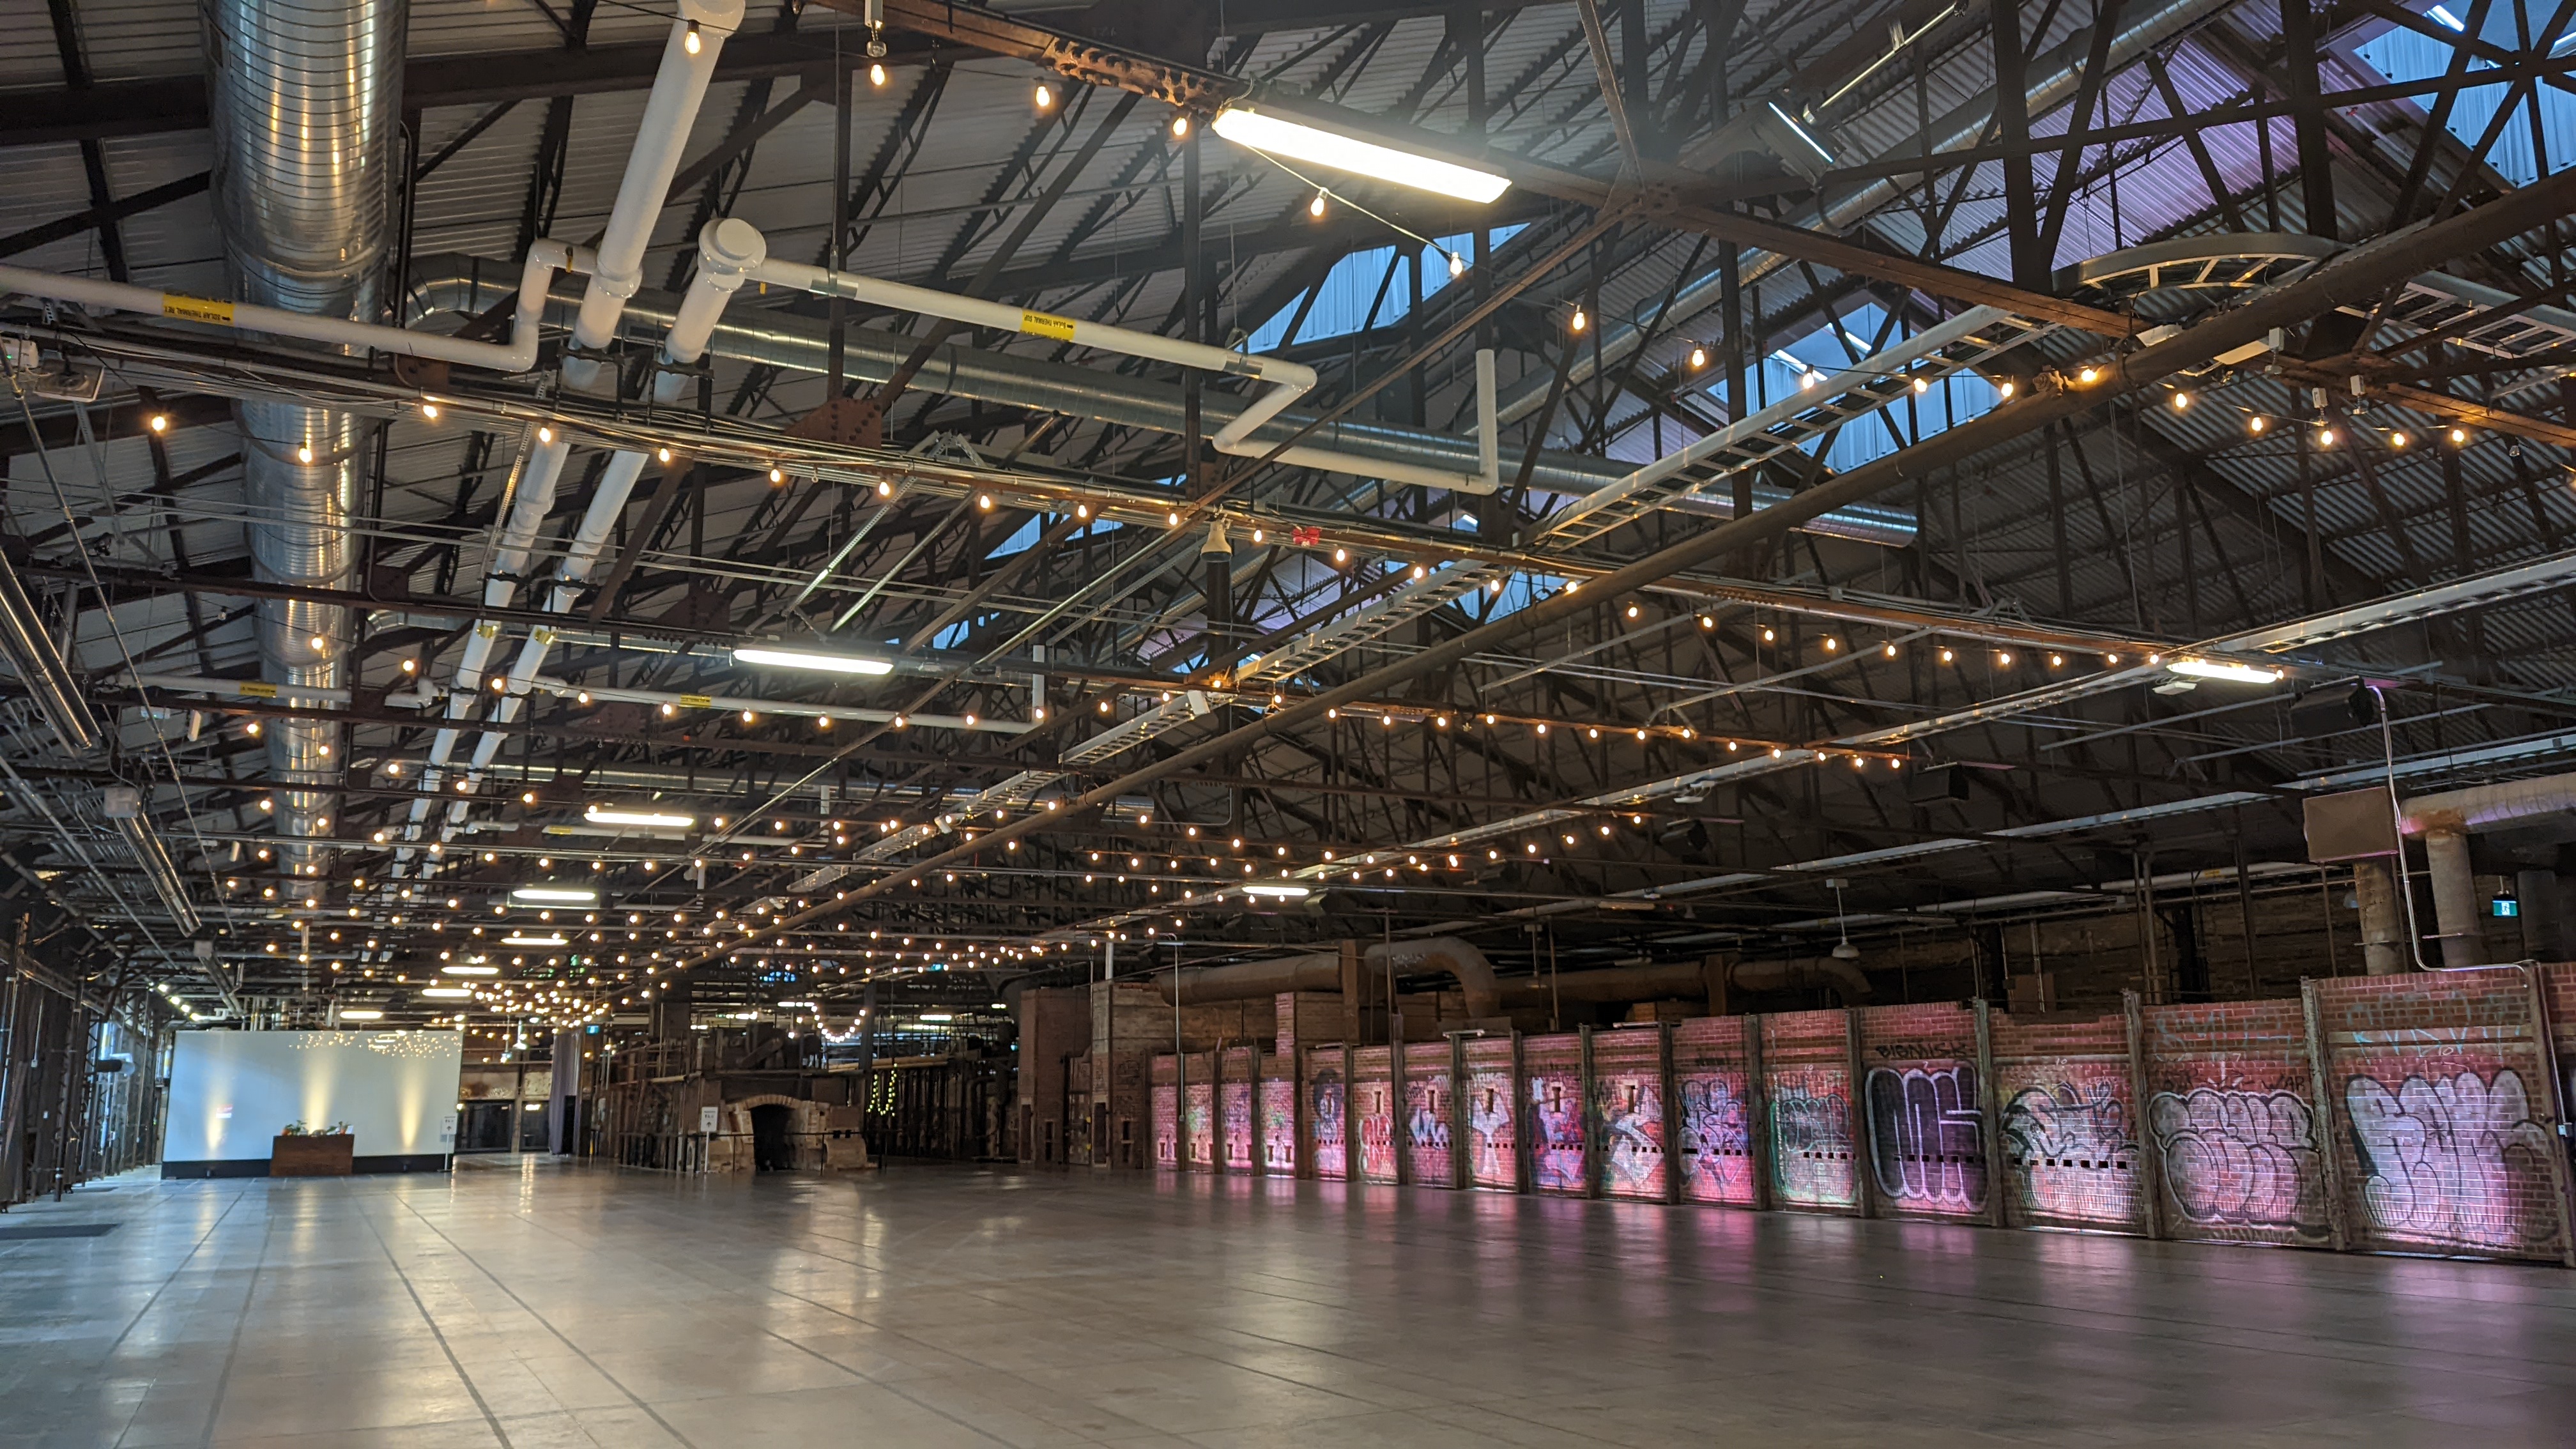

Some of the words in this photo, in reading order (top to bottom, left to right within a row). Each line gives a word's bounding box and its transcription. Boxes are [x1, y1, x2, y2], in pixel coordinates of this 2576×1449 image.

[176, 308, 202, 318] THERMAL
[203, 312, 220, 321] SOLAR
[1034, 316, 1052, 326] THERMAL
[1053, 320, 1066, 329] SOLAR
